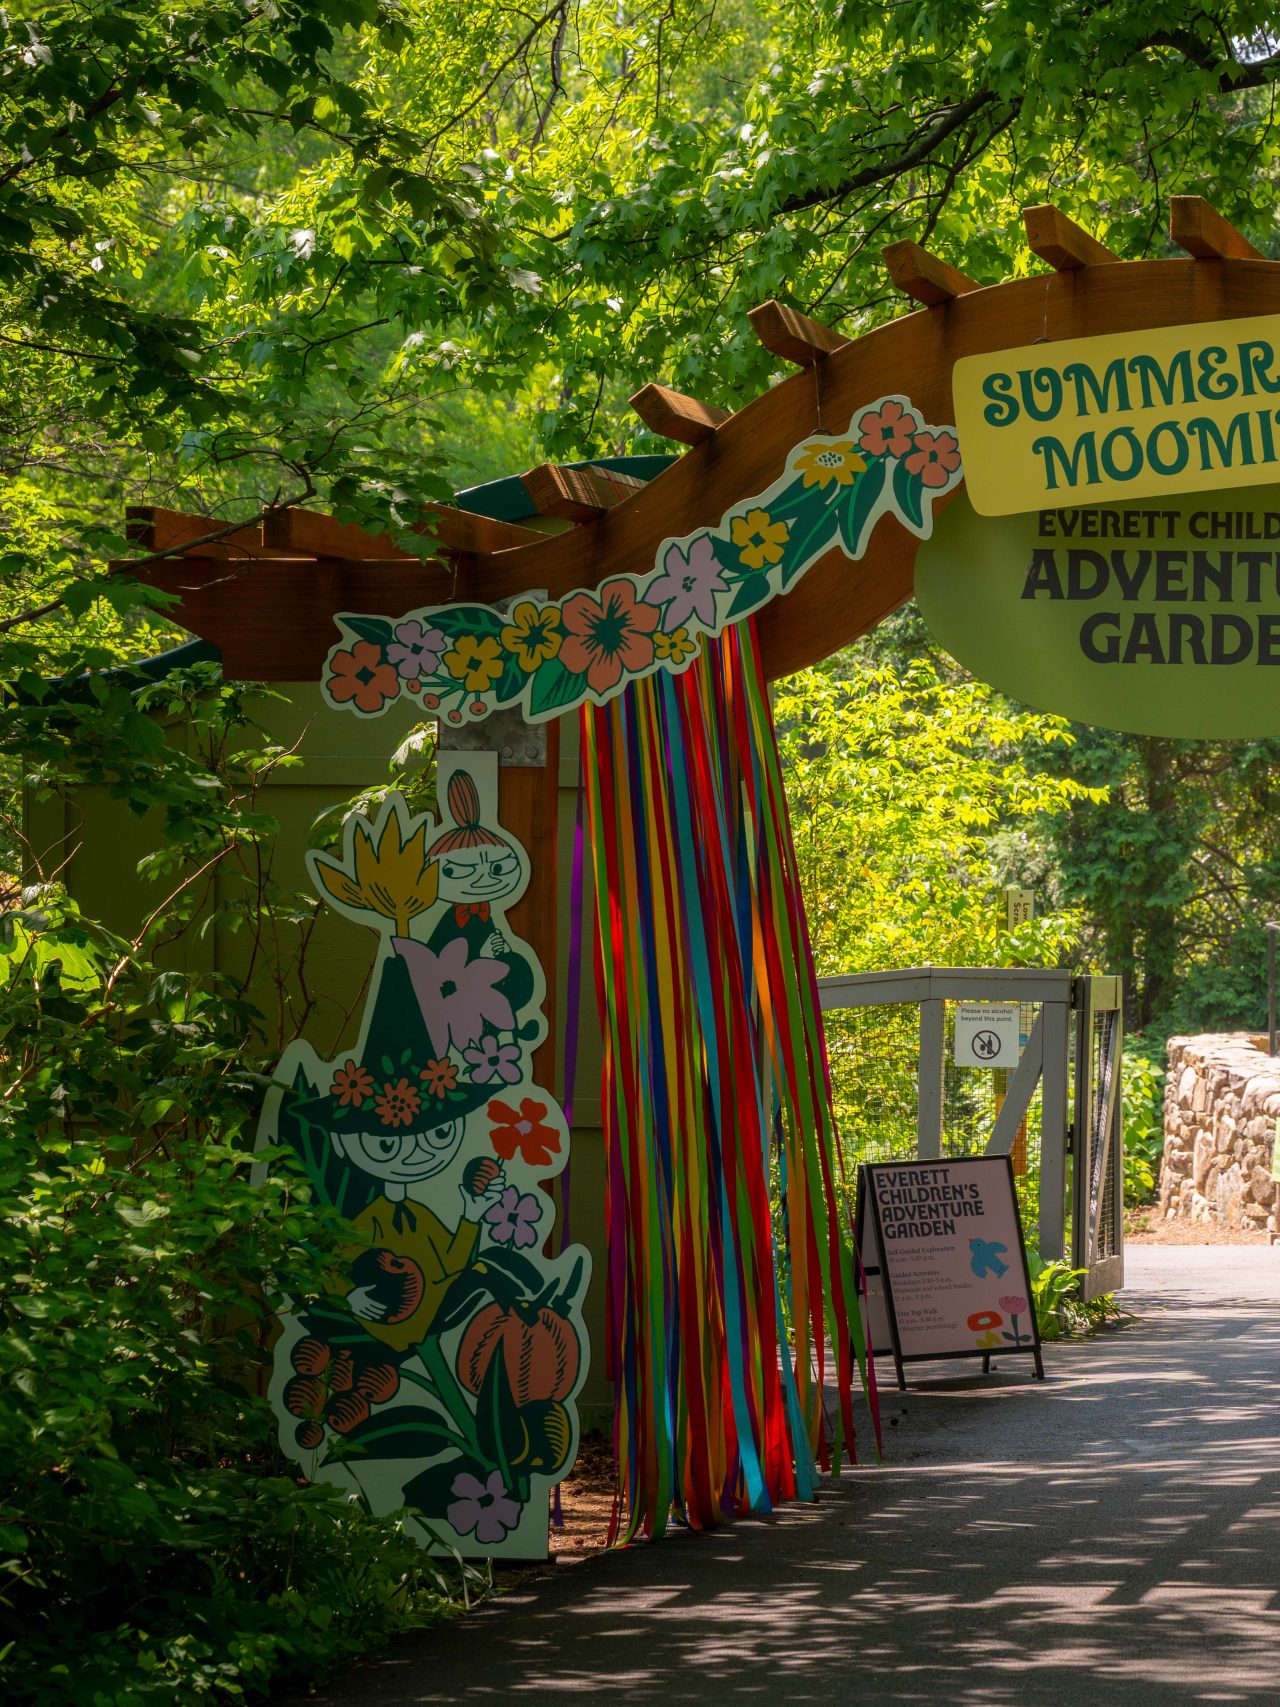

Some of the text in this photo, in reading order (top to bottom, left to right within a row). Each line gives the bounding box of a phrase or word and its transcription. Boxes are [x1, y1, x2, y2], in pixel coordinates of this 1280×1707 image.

[1038, 509, 1180, 540] EVERETT
[876, 1168, 950, 1188] EVERETT
[878, 1184, 980, 1205] CHILDREN'S
[882, 1200, 984, 1222] ADVENTURE
[884, 1220, 956, 1240] GARDEN
